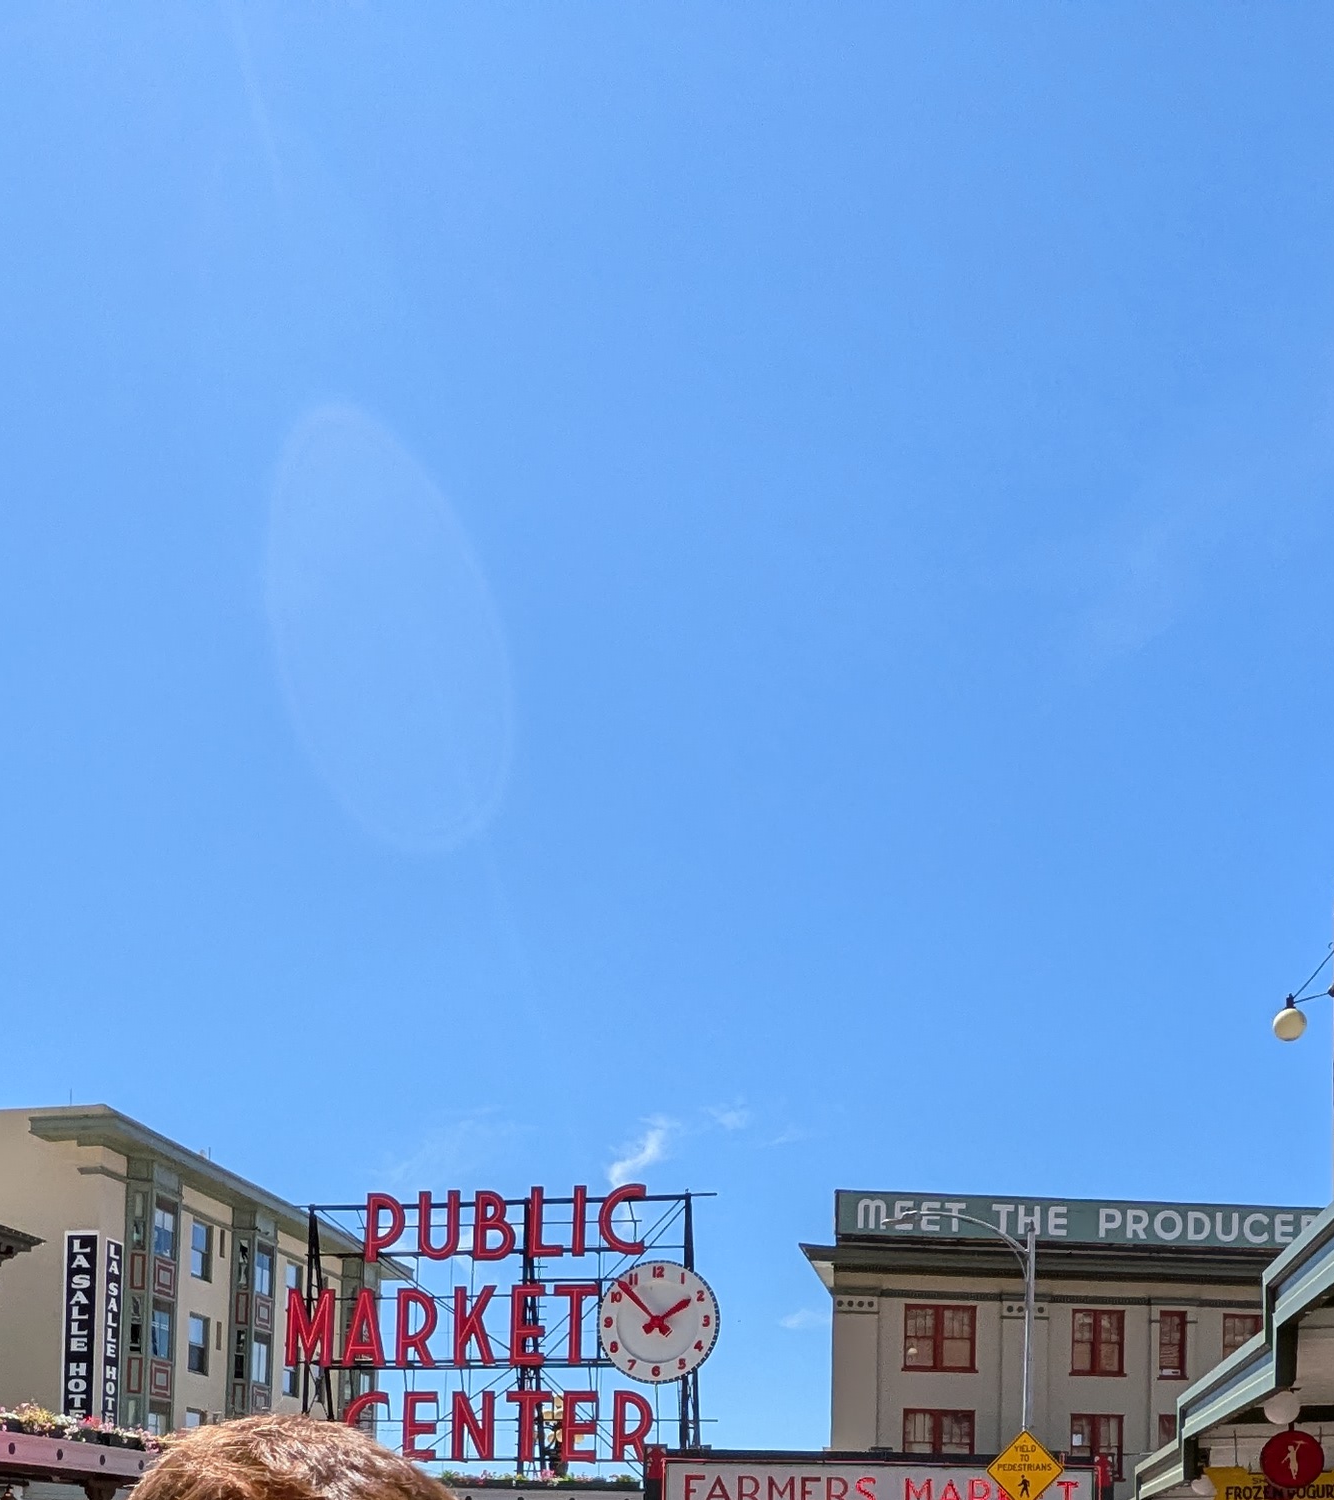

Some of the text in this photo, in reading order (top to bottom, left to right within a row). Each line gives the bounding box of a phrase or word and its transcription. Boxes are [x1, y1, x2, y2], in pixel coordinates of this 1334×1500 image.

[365, 1183, 647, 1263] PUBLIC
[857, 1198, 967, 1234] MEET
[992, 1203, 1068, 1236] THE
[652, 1266, 665, 1278] 12
[628, 1273, 639, 1286] 11
[680, 1272, 685, 1285] 1
[610, 1291, 623, 1303] 10
[696, 1290, 705, 1302] 2
[106, 1282, 119, 1359] SALLE
[284, 1284, 600, 1368] MARKET
[604, 1316, 614, 1328] 9
[702, 1315, 711, 1327] 3
[67, 1239, 91, 1421] LA SALLE HOTE
[609, 1341, 619, 1353] 8
[693, 1340, 704, 1352] 4
[627, 1359, 637, 1370] 7
[677, 1358, 687, 1370] 5
[651, 1365, 661, 1377] 6
[105, 1365, 118, 1426] HOTE
[1014, 1444, 1037, 1453] YIELD
[1019, 1454, 1030, 1462] TO
[997, 1463, 1053, 1472] PEDESTRIANS
